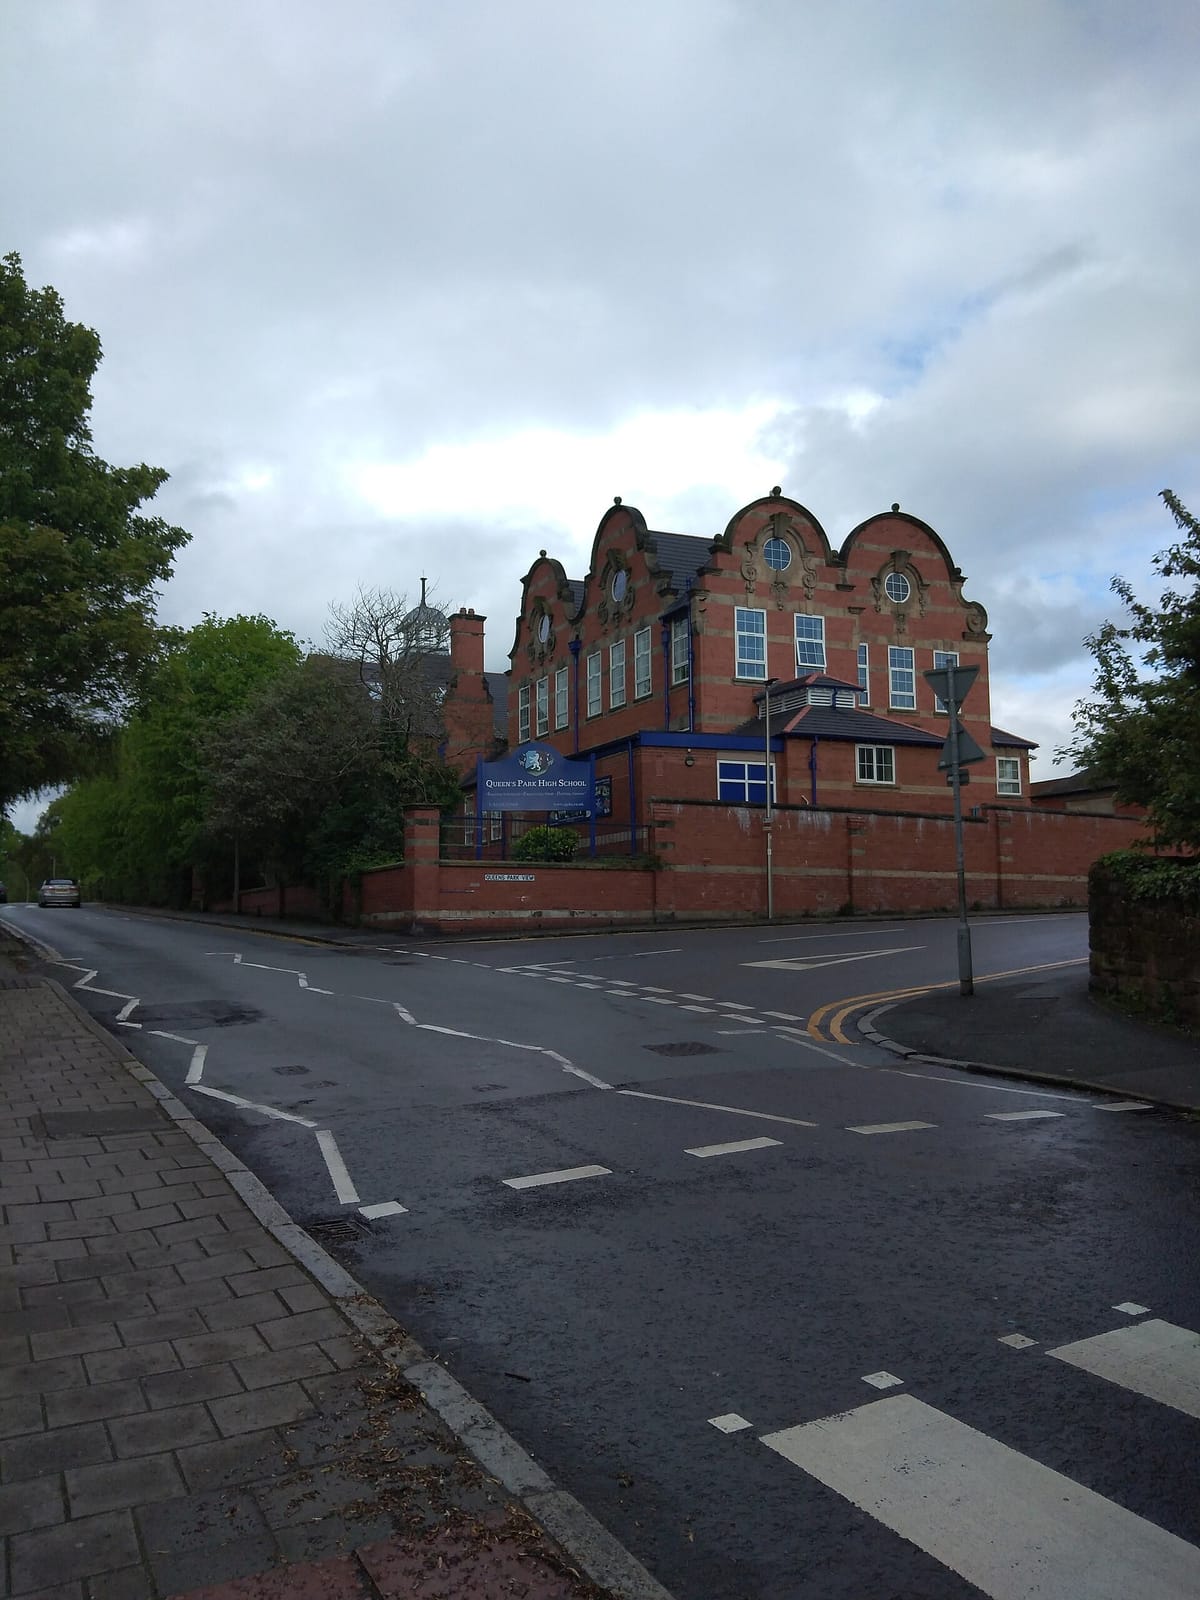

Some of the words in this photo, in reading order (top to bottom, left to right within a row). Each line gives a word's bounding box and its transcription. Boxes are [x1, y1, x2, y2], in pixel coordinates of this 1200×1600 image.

[486, 779, 516, 788] QUEEN'S
[517, 779, 537, 787] PARK
[538, 779, 557, 787] HIGH
[558, 779, 587, 787] SCHOOL
